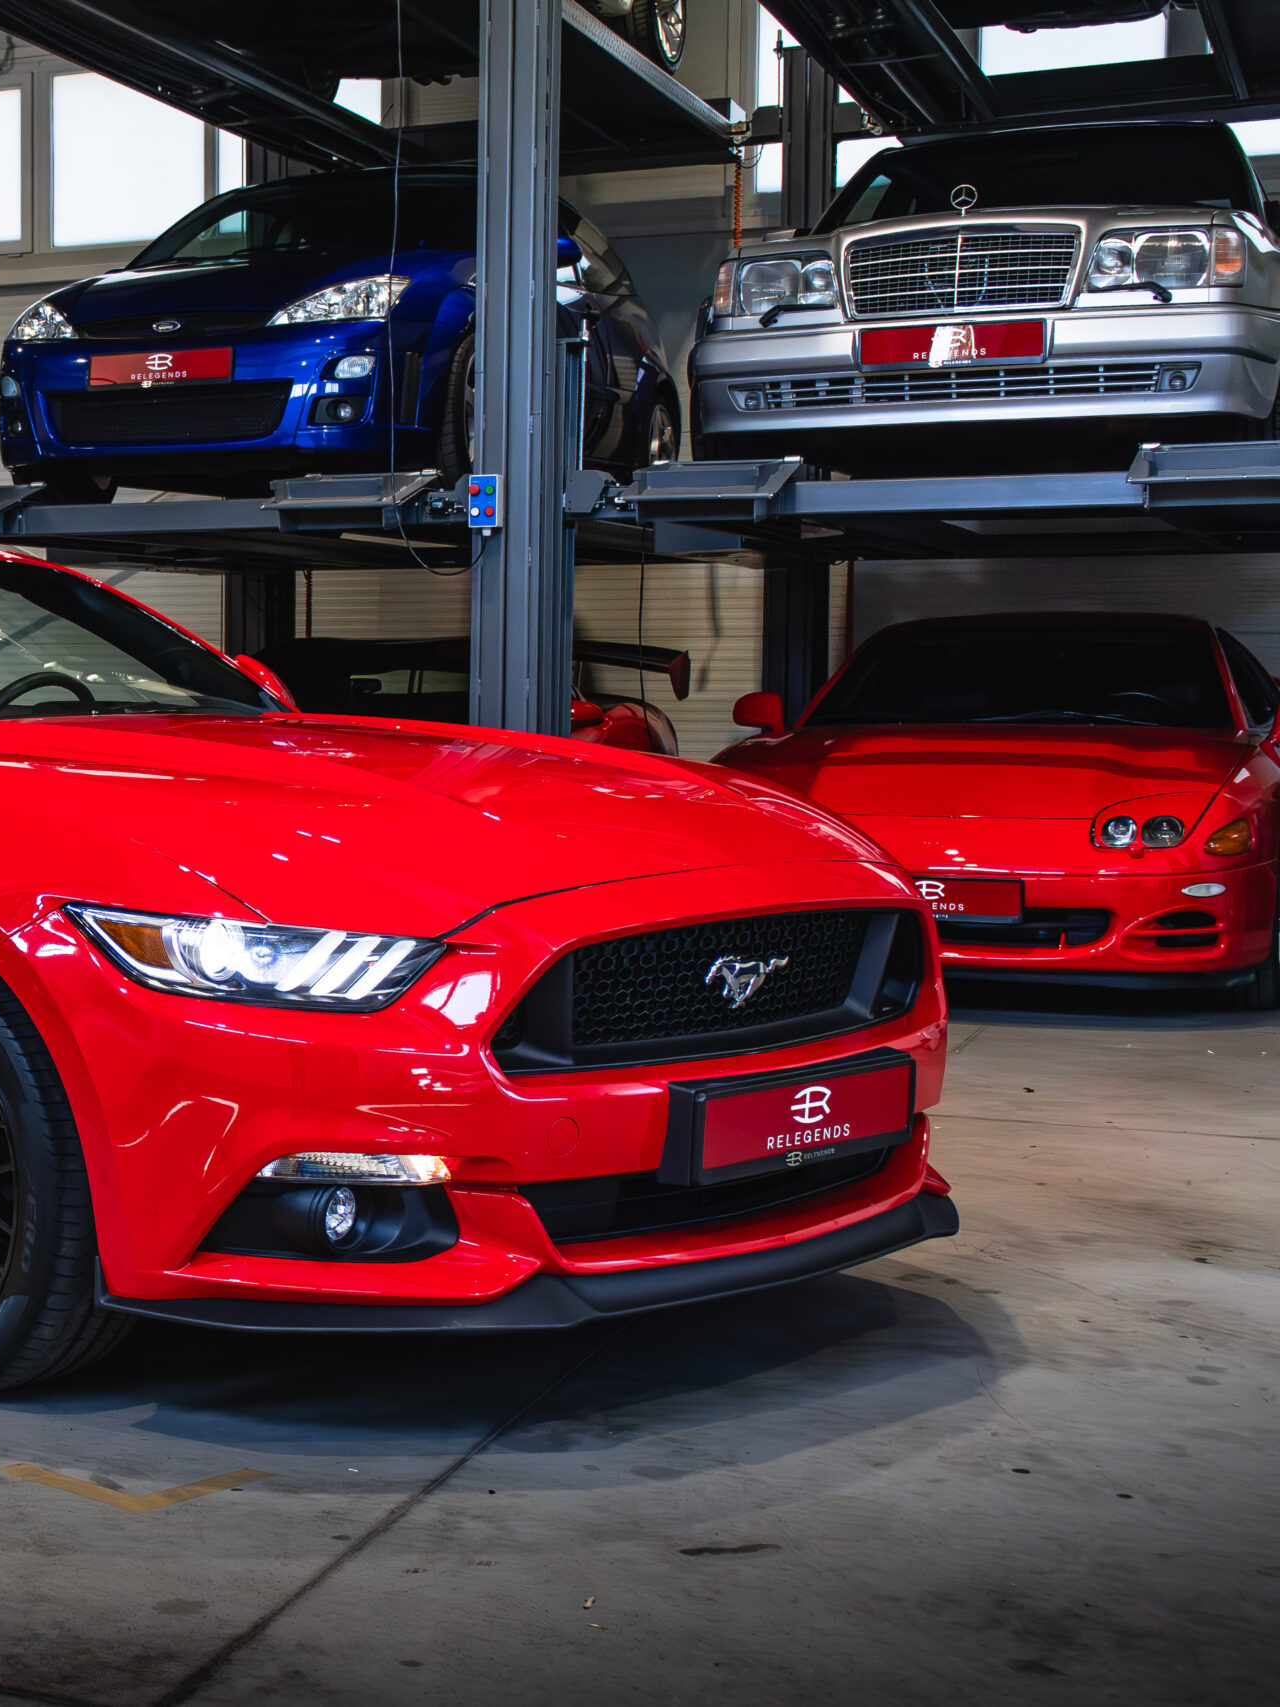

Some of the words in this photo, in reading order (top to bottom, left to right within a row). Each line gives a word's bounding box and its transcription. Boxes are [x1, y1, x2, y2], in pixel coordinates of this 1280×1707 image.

[913, 348, 987, 360] REENDS
[130, 370, 188, 380] RELEGENDS
[767, 1123, 850, 1150] RELEGENDS
